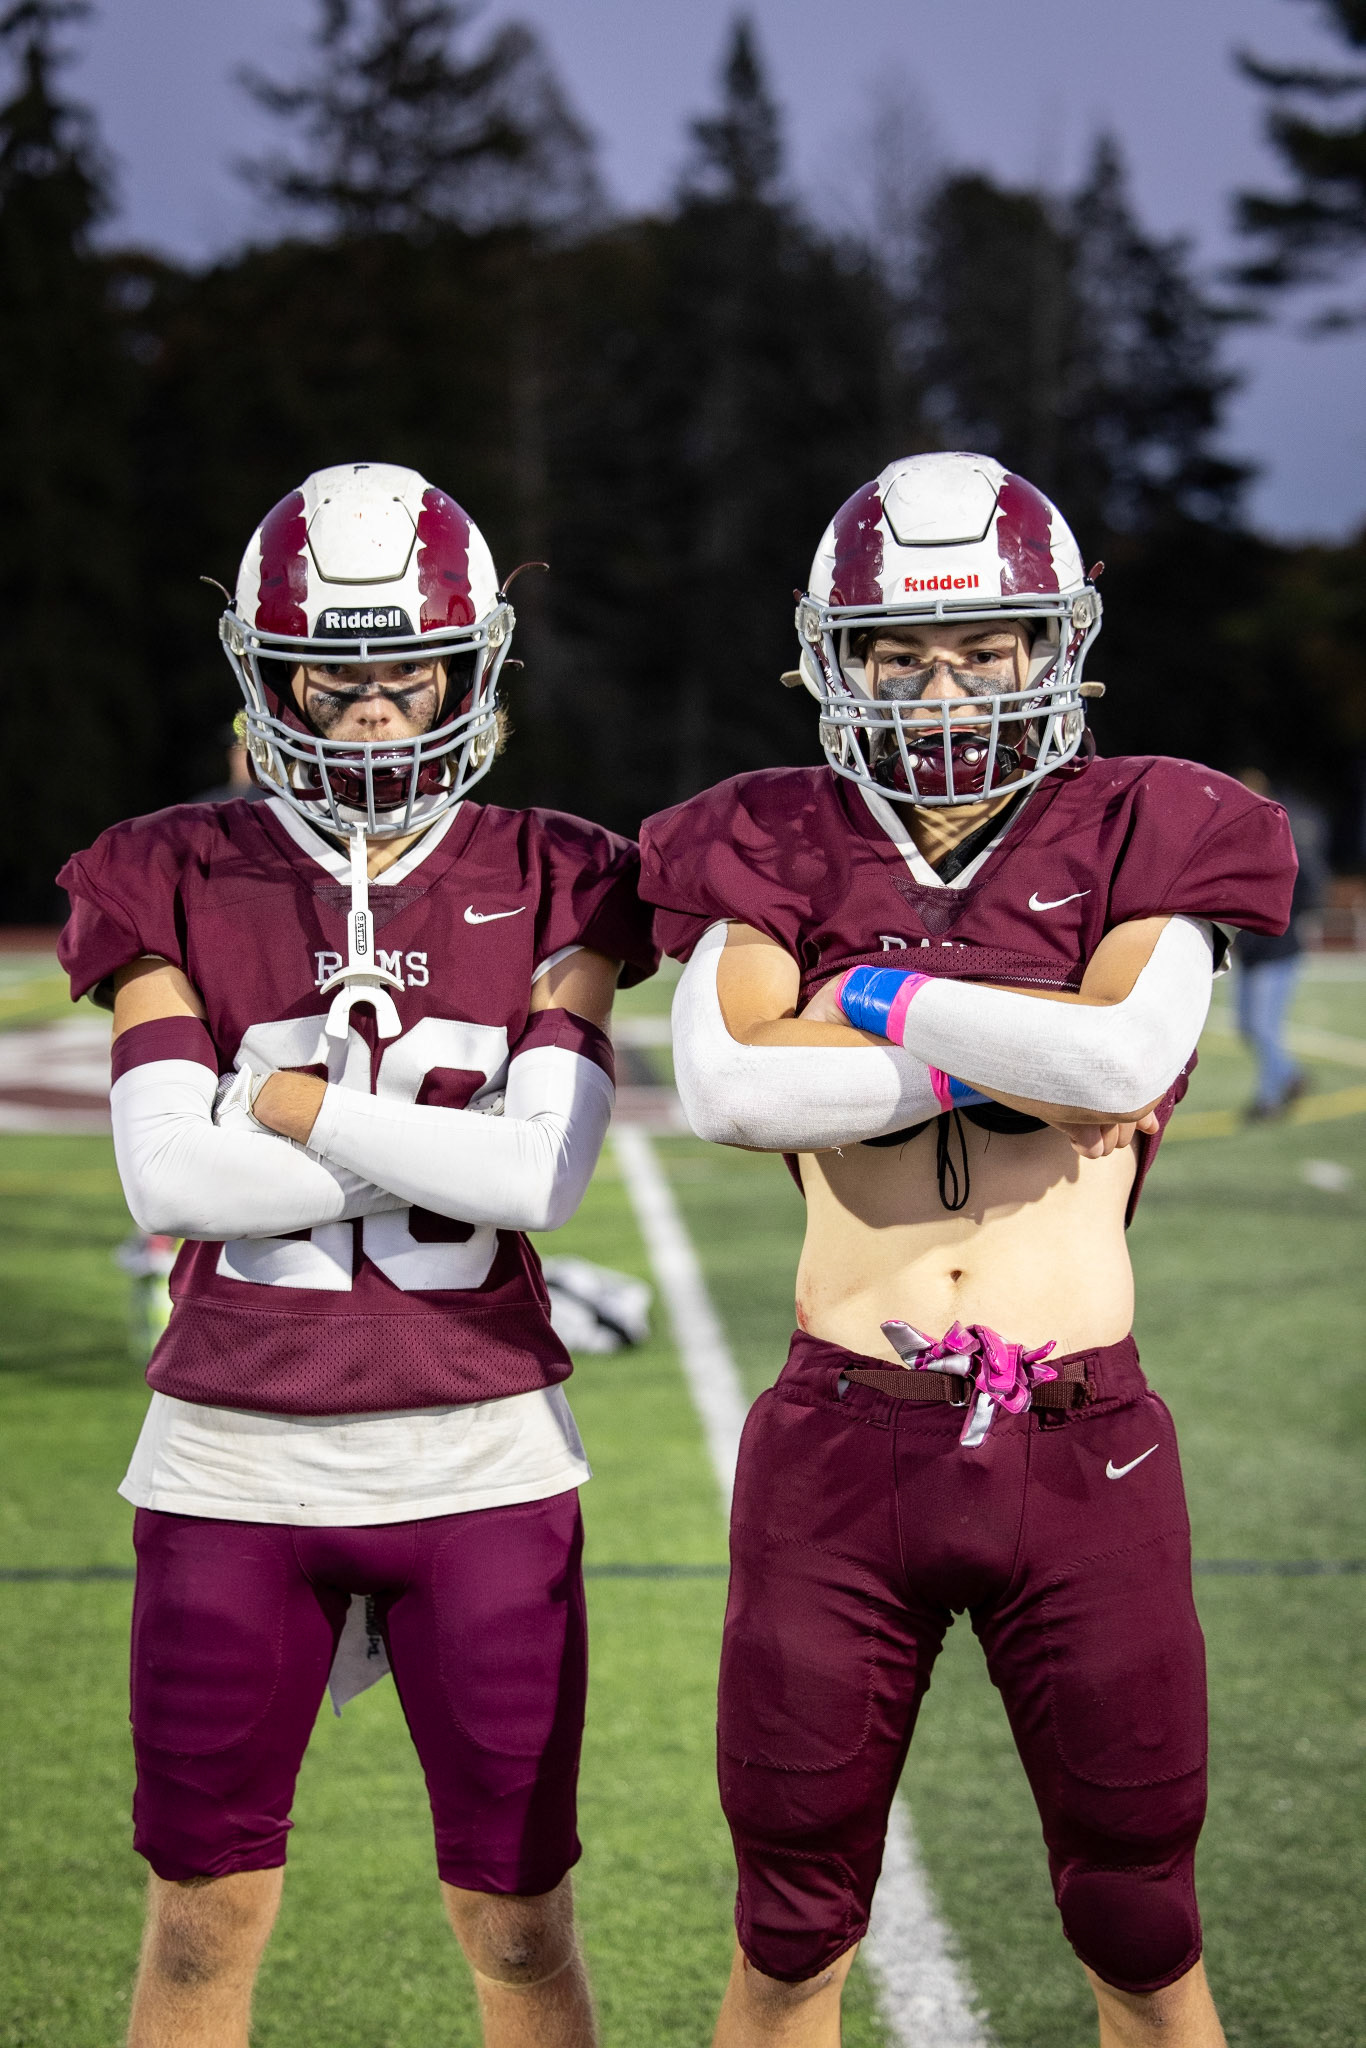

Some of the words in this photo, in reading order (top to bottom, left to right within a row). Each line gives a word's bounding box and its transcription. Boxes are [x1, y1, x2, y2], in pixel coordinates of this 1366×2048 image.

[904, 574, 979, 593] Riddell
[325, 609, 401, 629] Riddell
[356, 914, 366, 952] BATTLE
[314, 949, 430, 987] RMS
